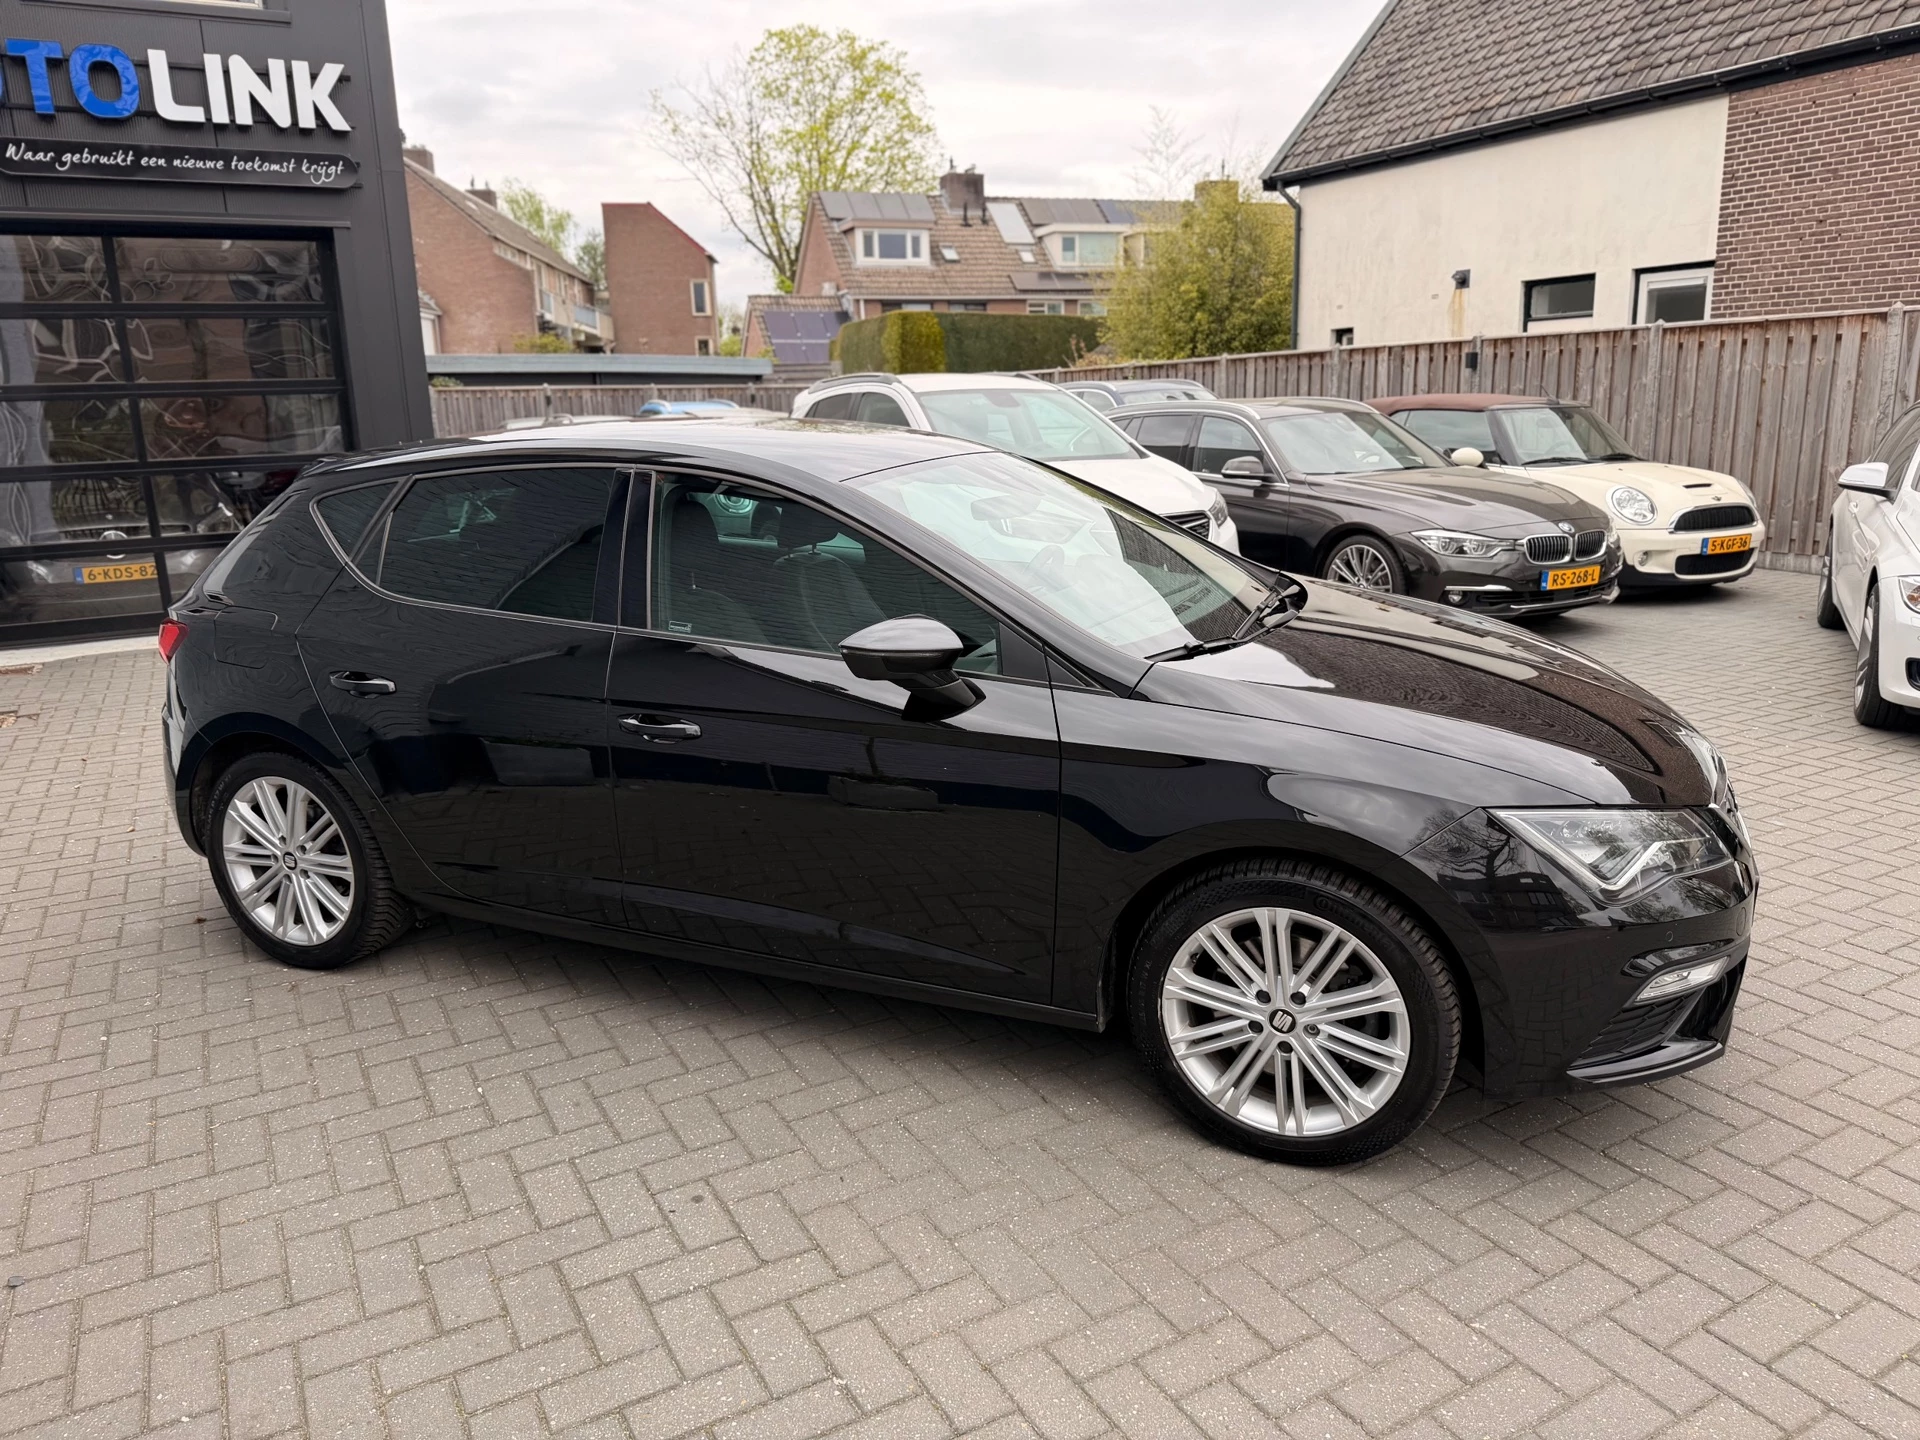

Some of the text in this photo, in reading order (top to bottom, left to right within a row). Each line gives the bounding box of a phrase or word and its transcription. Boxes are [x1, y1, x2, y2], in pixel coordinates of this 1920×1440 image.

[0, 38, 352, 132] TOLINK
[5, 142, 344, 185] Waar gebruikt een nieuwe toekomst krijgt
[1710, 536, 1748, 552] 5-KGF-36
[87, 563, 158, 581] 6-KDS-82
[1551, 568, 1597, 587] RS-268-L
